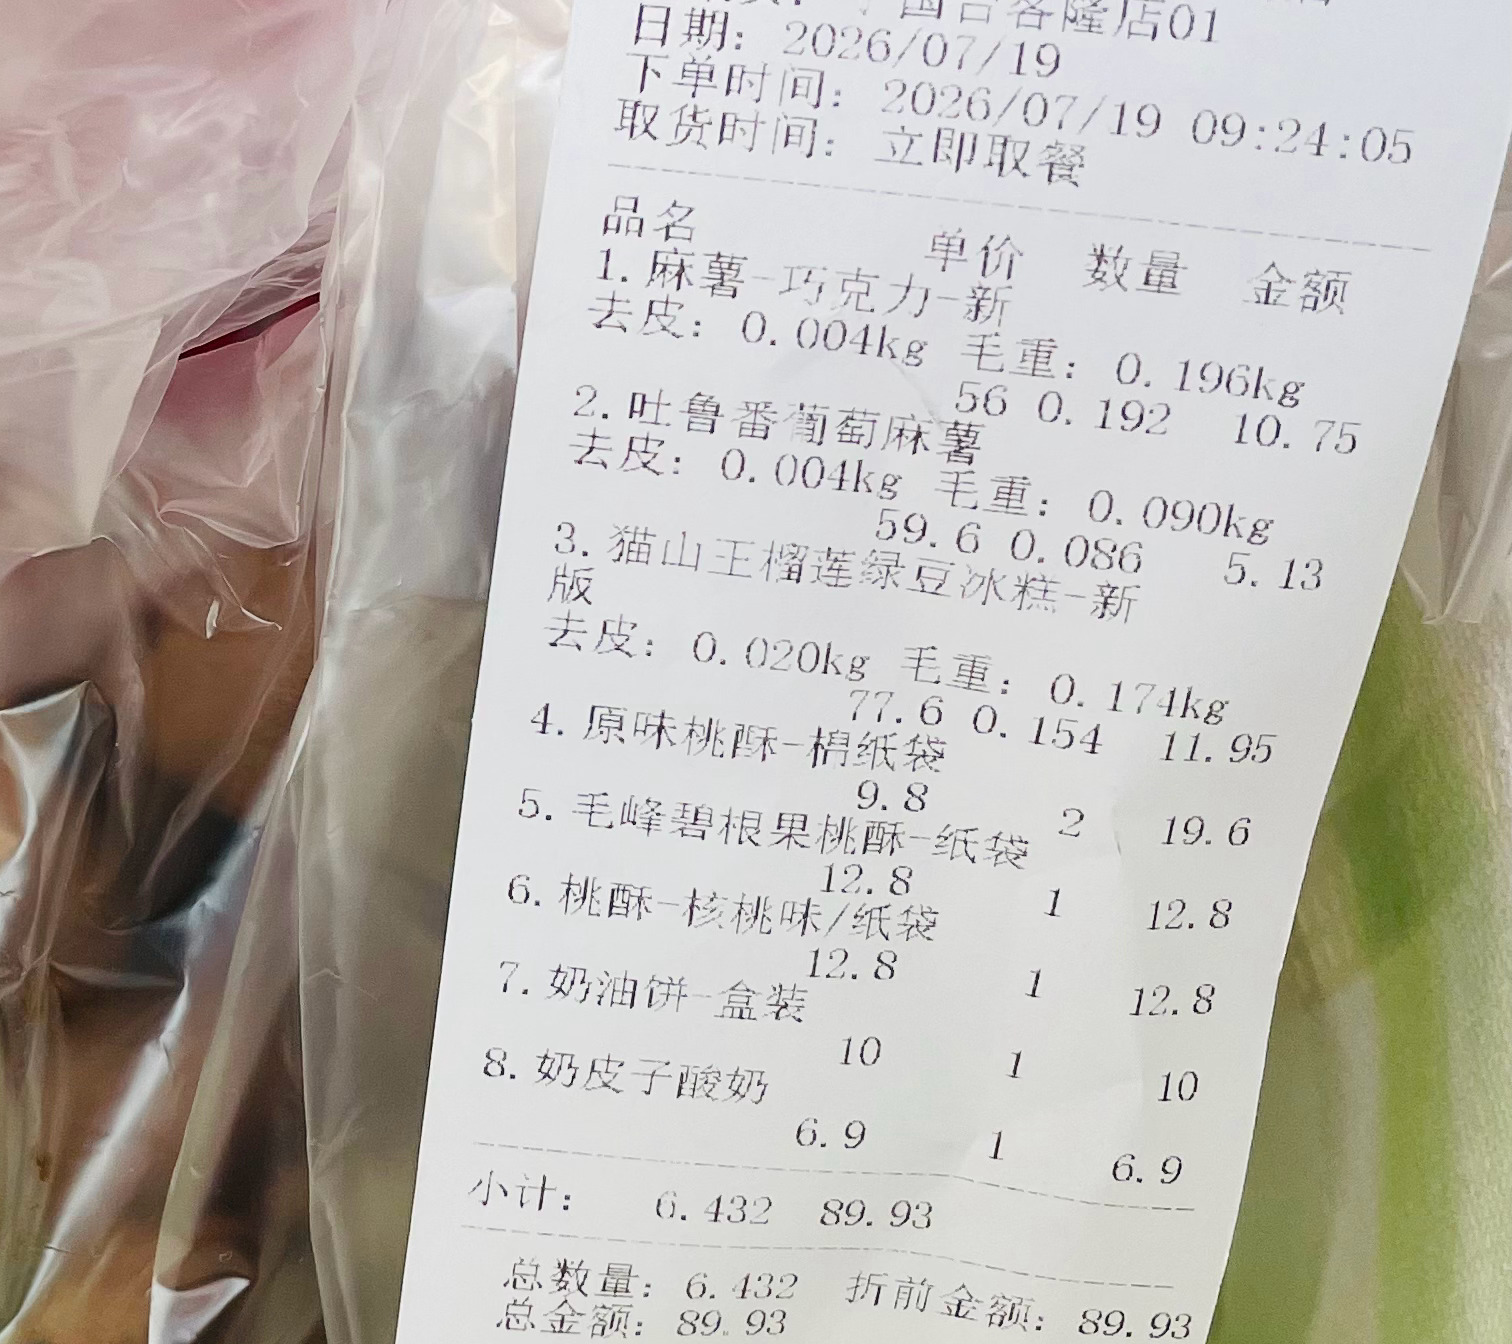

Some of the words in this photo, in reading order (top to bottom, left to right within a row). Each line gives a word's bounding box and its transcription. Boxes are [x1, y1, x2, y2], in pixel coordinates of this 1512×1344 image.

[1191, 108, 1416, 165] 09:24:05
[602, 194, 696, 243] 品名
[924, 227, 1024, 281] 单价
[1082, 242, 1189, 296] 数量
[1241, 259, 1353, 315] 金额
[954, 380, 1008, 418] 56
[1037, 389, 1172, 436] 0.192
[1233, 412, 1363, 455] 10.75
[546, 562, 595, 606] 版
[874, 507, 982, 555] 59.6
[1010, 528, 1144, 575] 0.086
[1223, 551, 1324, 591] 5.13
[849, 689, 944, 726] 77.6
[972, 703, 1104, 755] 0.154
[1160, 731, 1274, 767] 11.95
[856, 779, 929, 813] 9.8
[1058, 808, 1086, 839] 2
[1161, 815, 1251, 848] 19.6
[820, 862, 914, 897] 12.8
[1042, 888, 1063, 919] 1
[1146, 897, 1233, 932] 12.8
[807, 948, 898, 982] 12.8
[1024, 968, 1044, 1000] 1
[1128, 983, 1217, 1018] 12.8
[838, 1036, 883, 1068] 10
[1004, 1049, 1025, 1080] 1
[1157, 1071, 1201, 1104] 10
[795, 1117, 869, 1150] 6.9
[987, 1130, 1006, 1162] 1
[1111, 1153, 1184, 1187] 6.9
[655, 1189, 773, 1225] 6.432
[819, 1196, 934, 1231] 89.93
